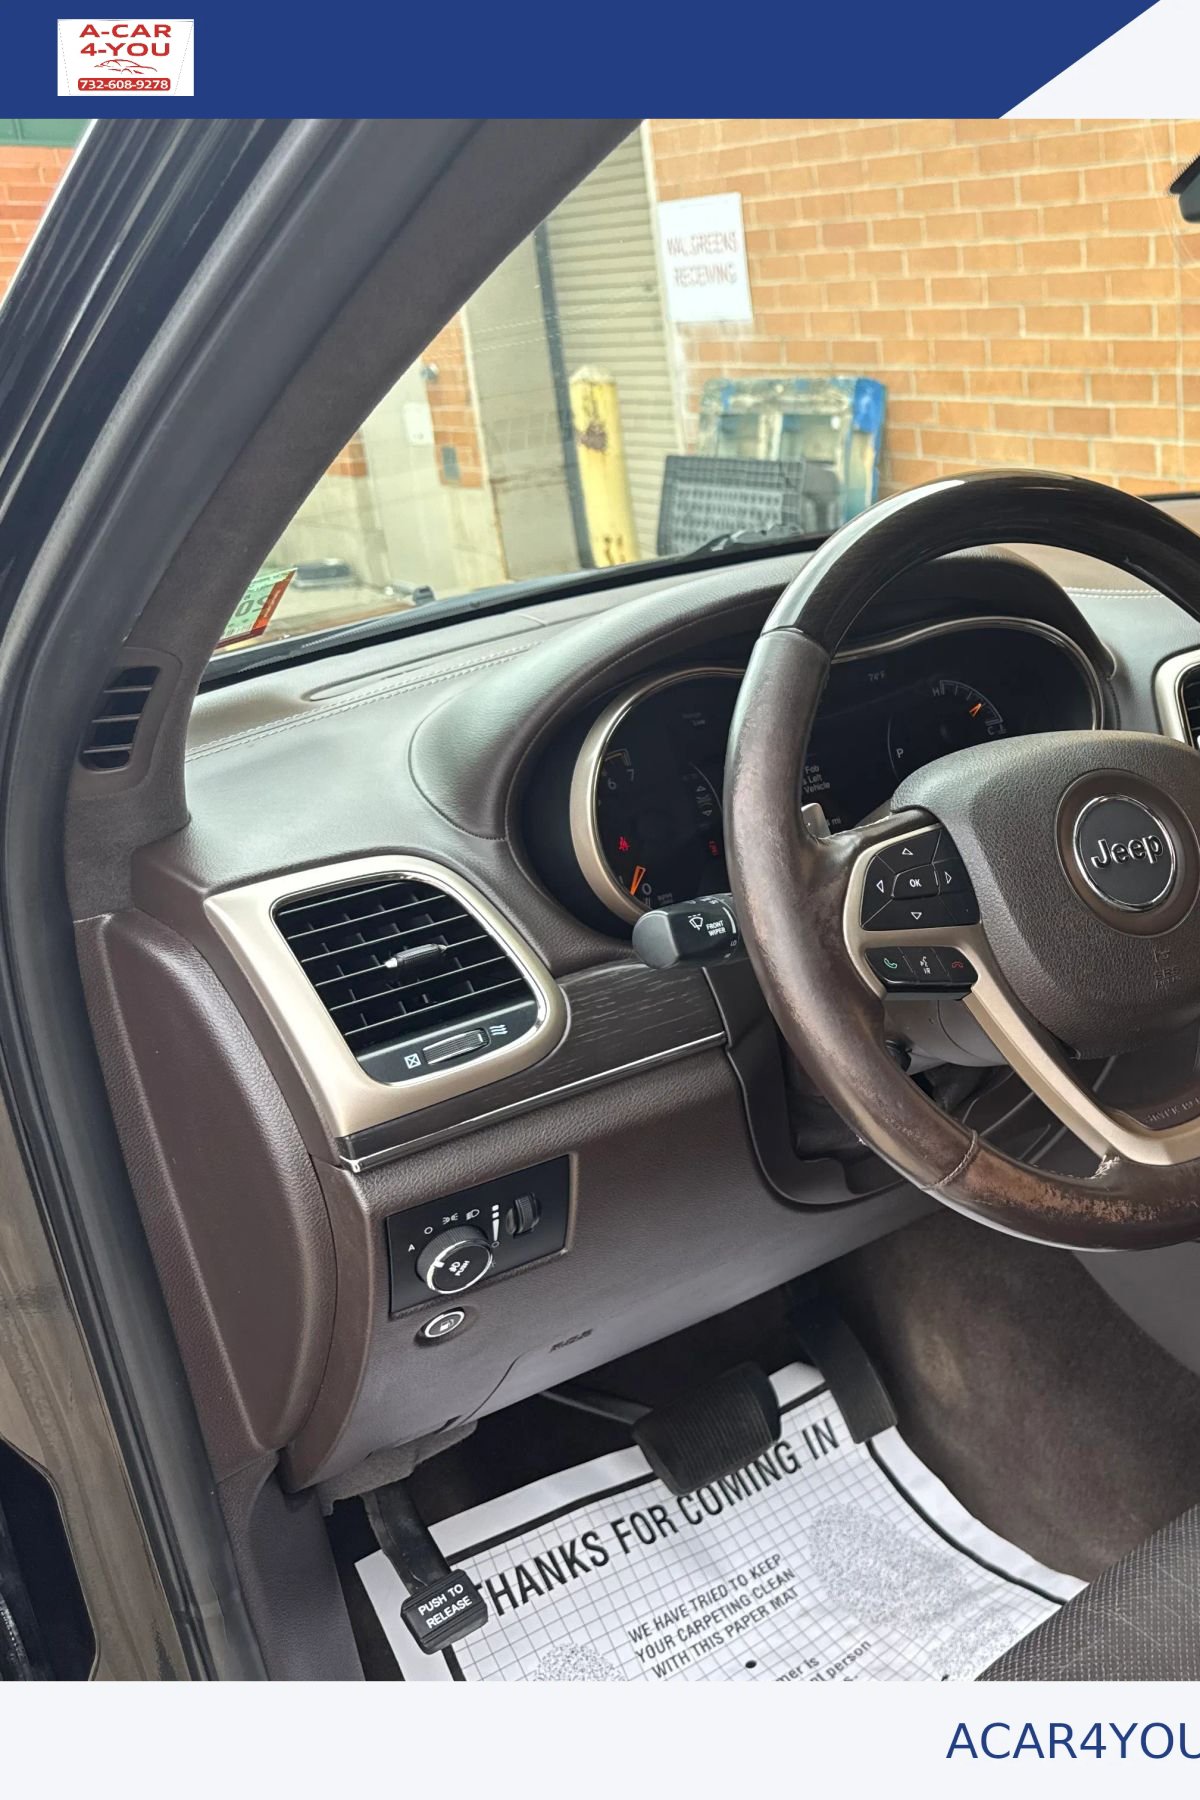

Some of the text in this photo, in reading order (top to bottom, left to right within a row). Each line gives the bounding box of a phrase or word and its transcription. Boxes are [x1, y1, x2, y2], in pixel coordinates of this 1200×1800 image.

[1090, 834, 1163, 869] Jeep
[909, 878, 922, 888] OK
[706, 920, 724, 931] FRONT
[708, 927, 727, 937] WIPER
[610, 1504, 679, 1554] FOR
[802, 1416, 840, 1461] IN
[417, 1583, 464, 1616] PUSH TO
[425, 1595, 473, 1629] RELEASE
[628, 1553, 782, 1644] WE HAVE TRIED TO KEEP
[635, 1568, 796, 1664] YOUR CARPETING CLEAN
[651, 1586, 799, 1679] WITH THIS PAPER MAT
[803, 1657, 820, 1669] is
[825, 1640, 872, 1679] person
